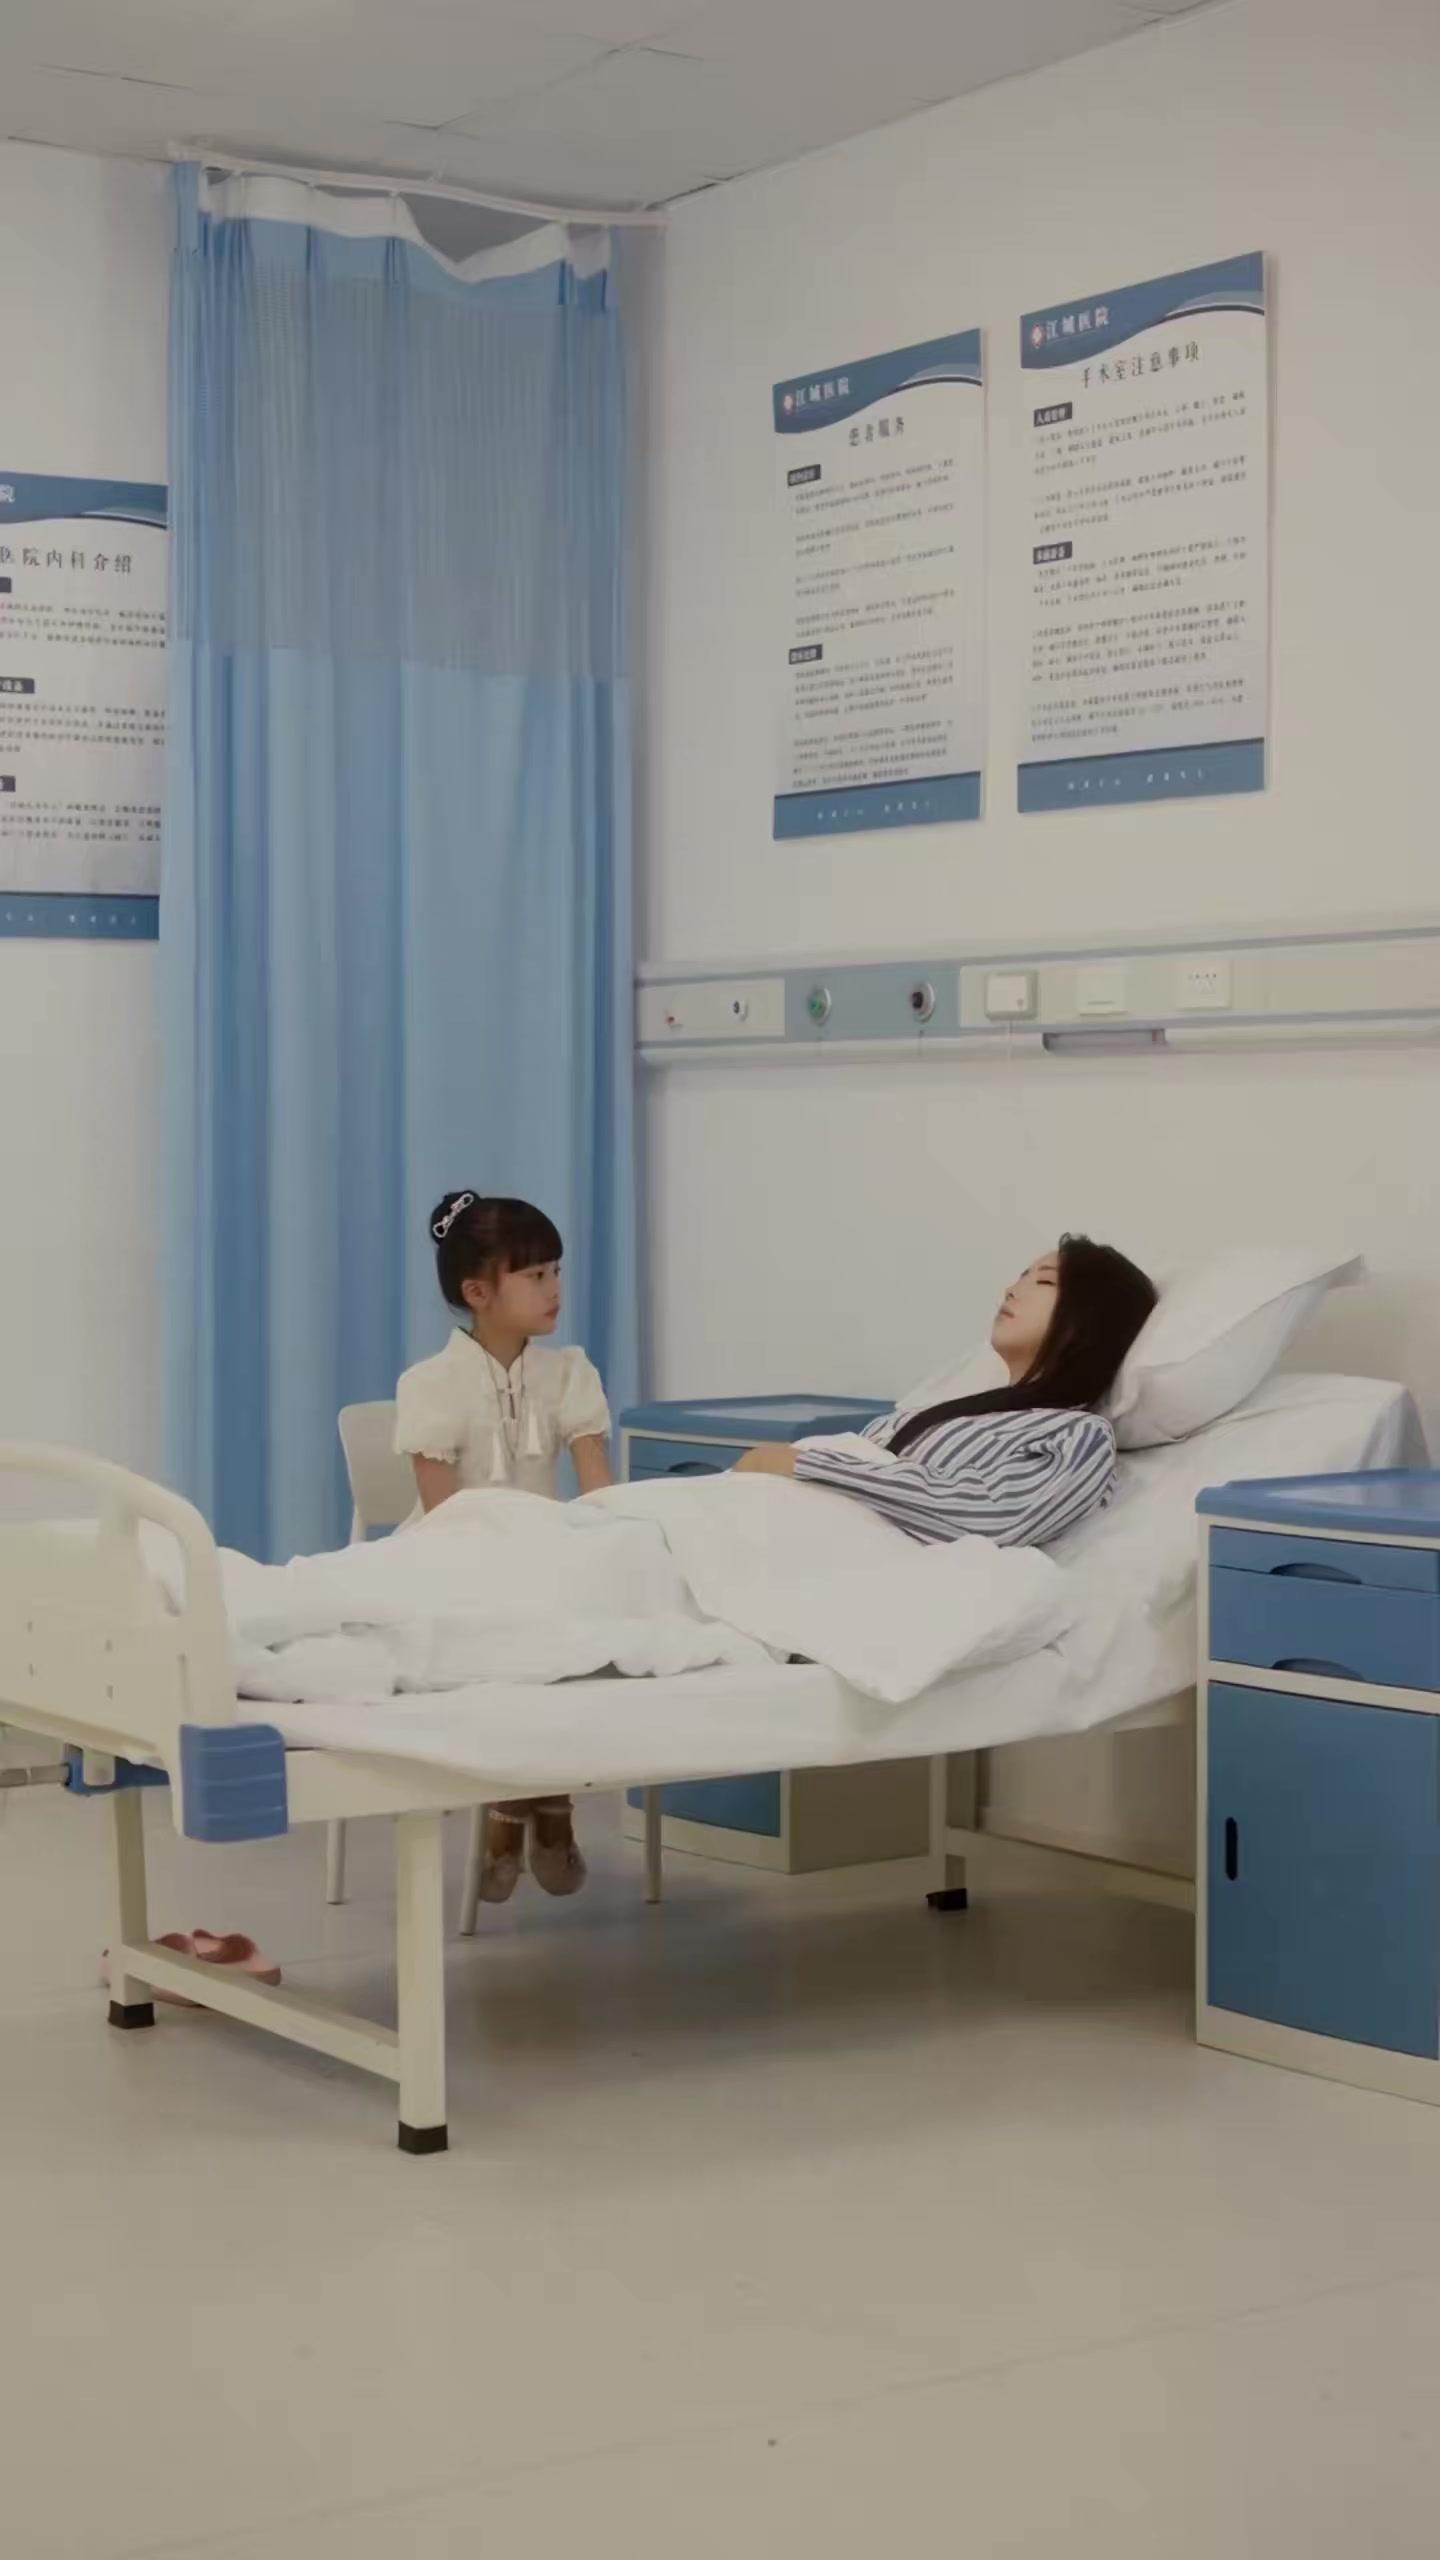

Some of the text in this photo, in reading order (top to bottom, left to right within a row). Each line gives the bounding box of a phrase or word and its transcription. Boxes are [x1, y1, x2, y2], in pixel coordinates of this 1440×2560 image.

[1046, 306, 1109, 339] 江城医院
[1083, 341, 1200, 389] 手术室注意事项
[796, 377, 849, 407] 江城医院
[849, 416, 904, 446] 患者服务
